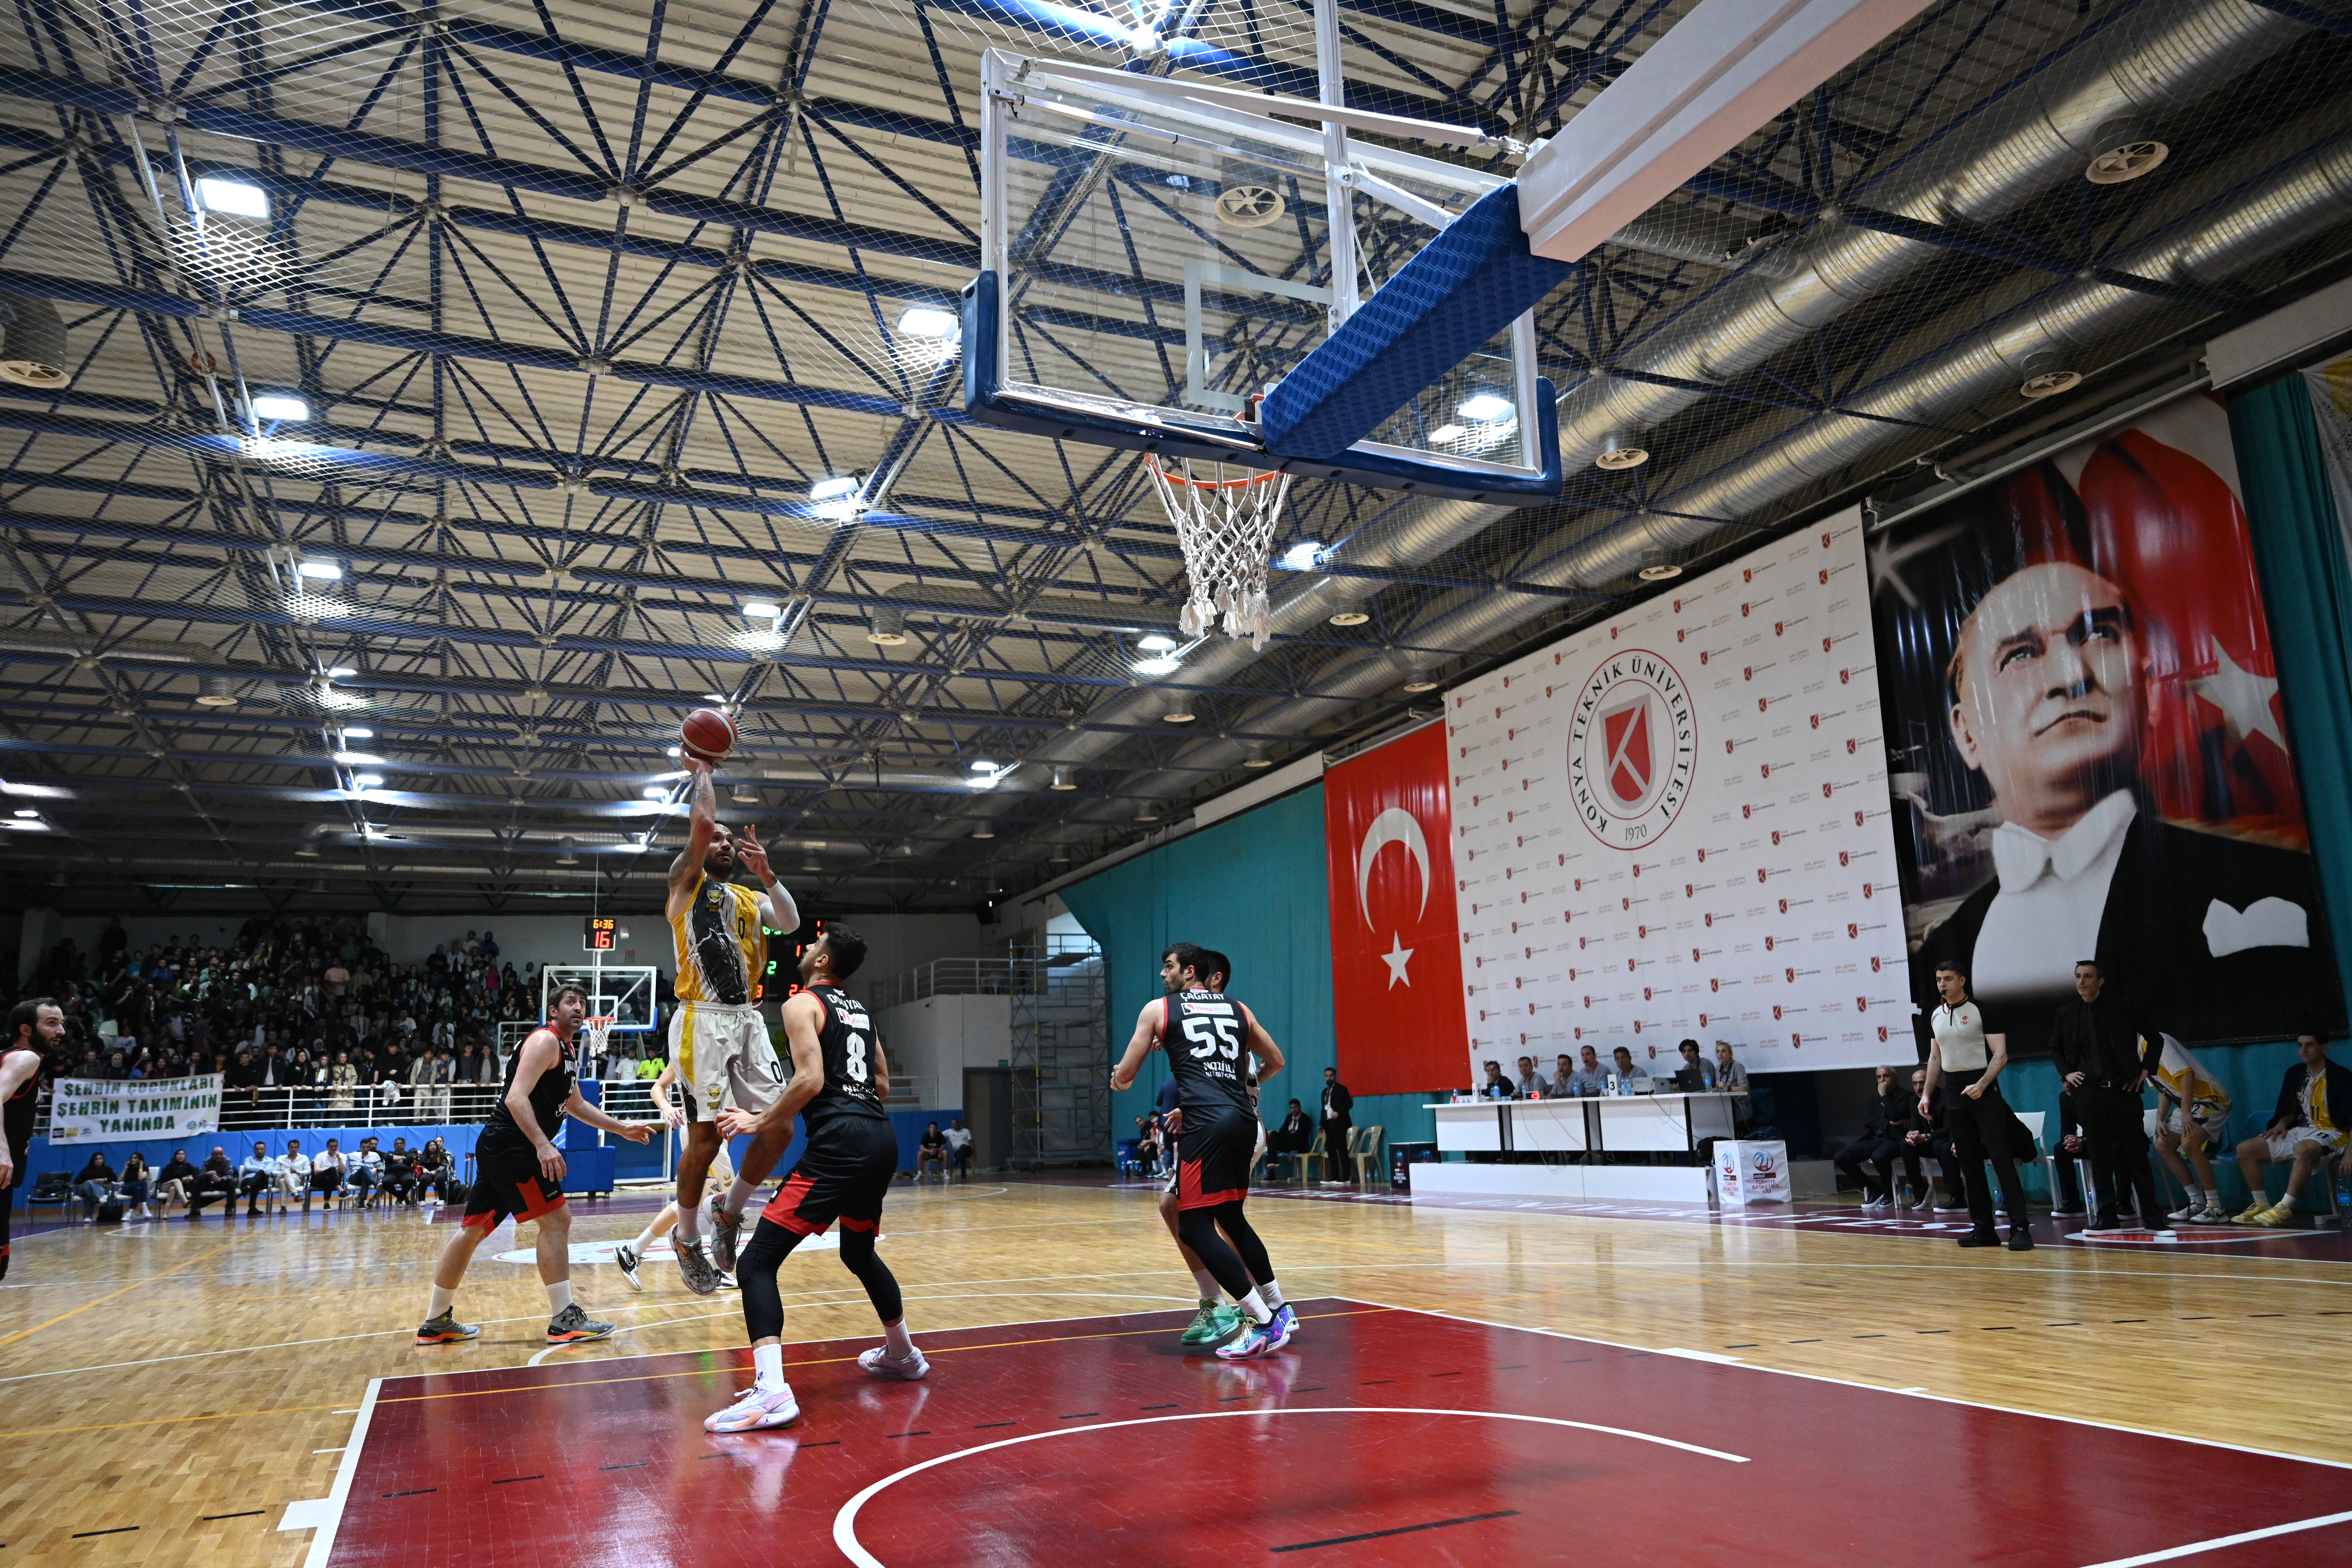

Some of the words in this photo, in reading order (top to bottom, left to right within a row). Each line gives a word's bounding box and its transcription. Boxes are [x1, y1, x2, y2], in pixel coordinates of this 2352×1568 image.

[1573, 662, 1623, 742] TEKNİK
[1632, 655, 1692, 819] ÜNİVERSİTESİ
[1573, 756, 1607, 833] KONYA
[1625, 824, 1647, 841] 1970
[593, 919, 614, 929] 6:36
[595, 931, 610, 948] 16
[767, 961, 777, 974] 2
[1182, 1016, 1239, 1060] 55
[847, 1032, 867, 1083] 8
[770, 1061, 783, 1084] 0
[65, 1080, 121, 1097] ŞEHRİN
[128, 1077, 214, 1096] ÇOCUKLARI
[1610, 1081, 1615, 1091] 3
[58, 1098, 119, 1118] ŞEHRİN
[128, 1094, 217, 1113] TAKIMININ
[2310, 1106, 2319, 1121] 11
[100, 1116, 175, 1133] YANINDA
